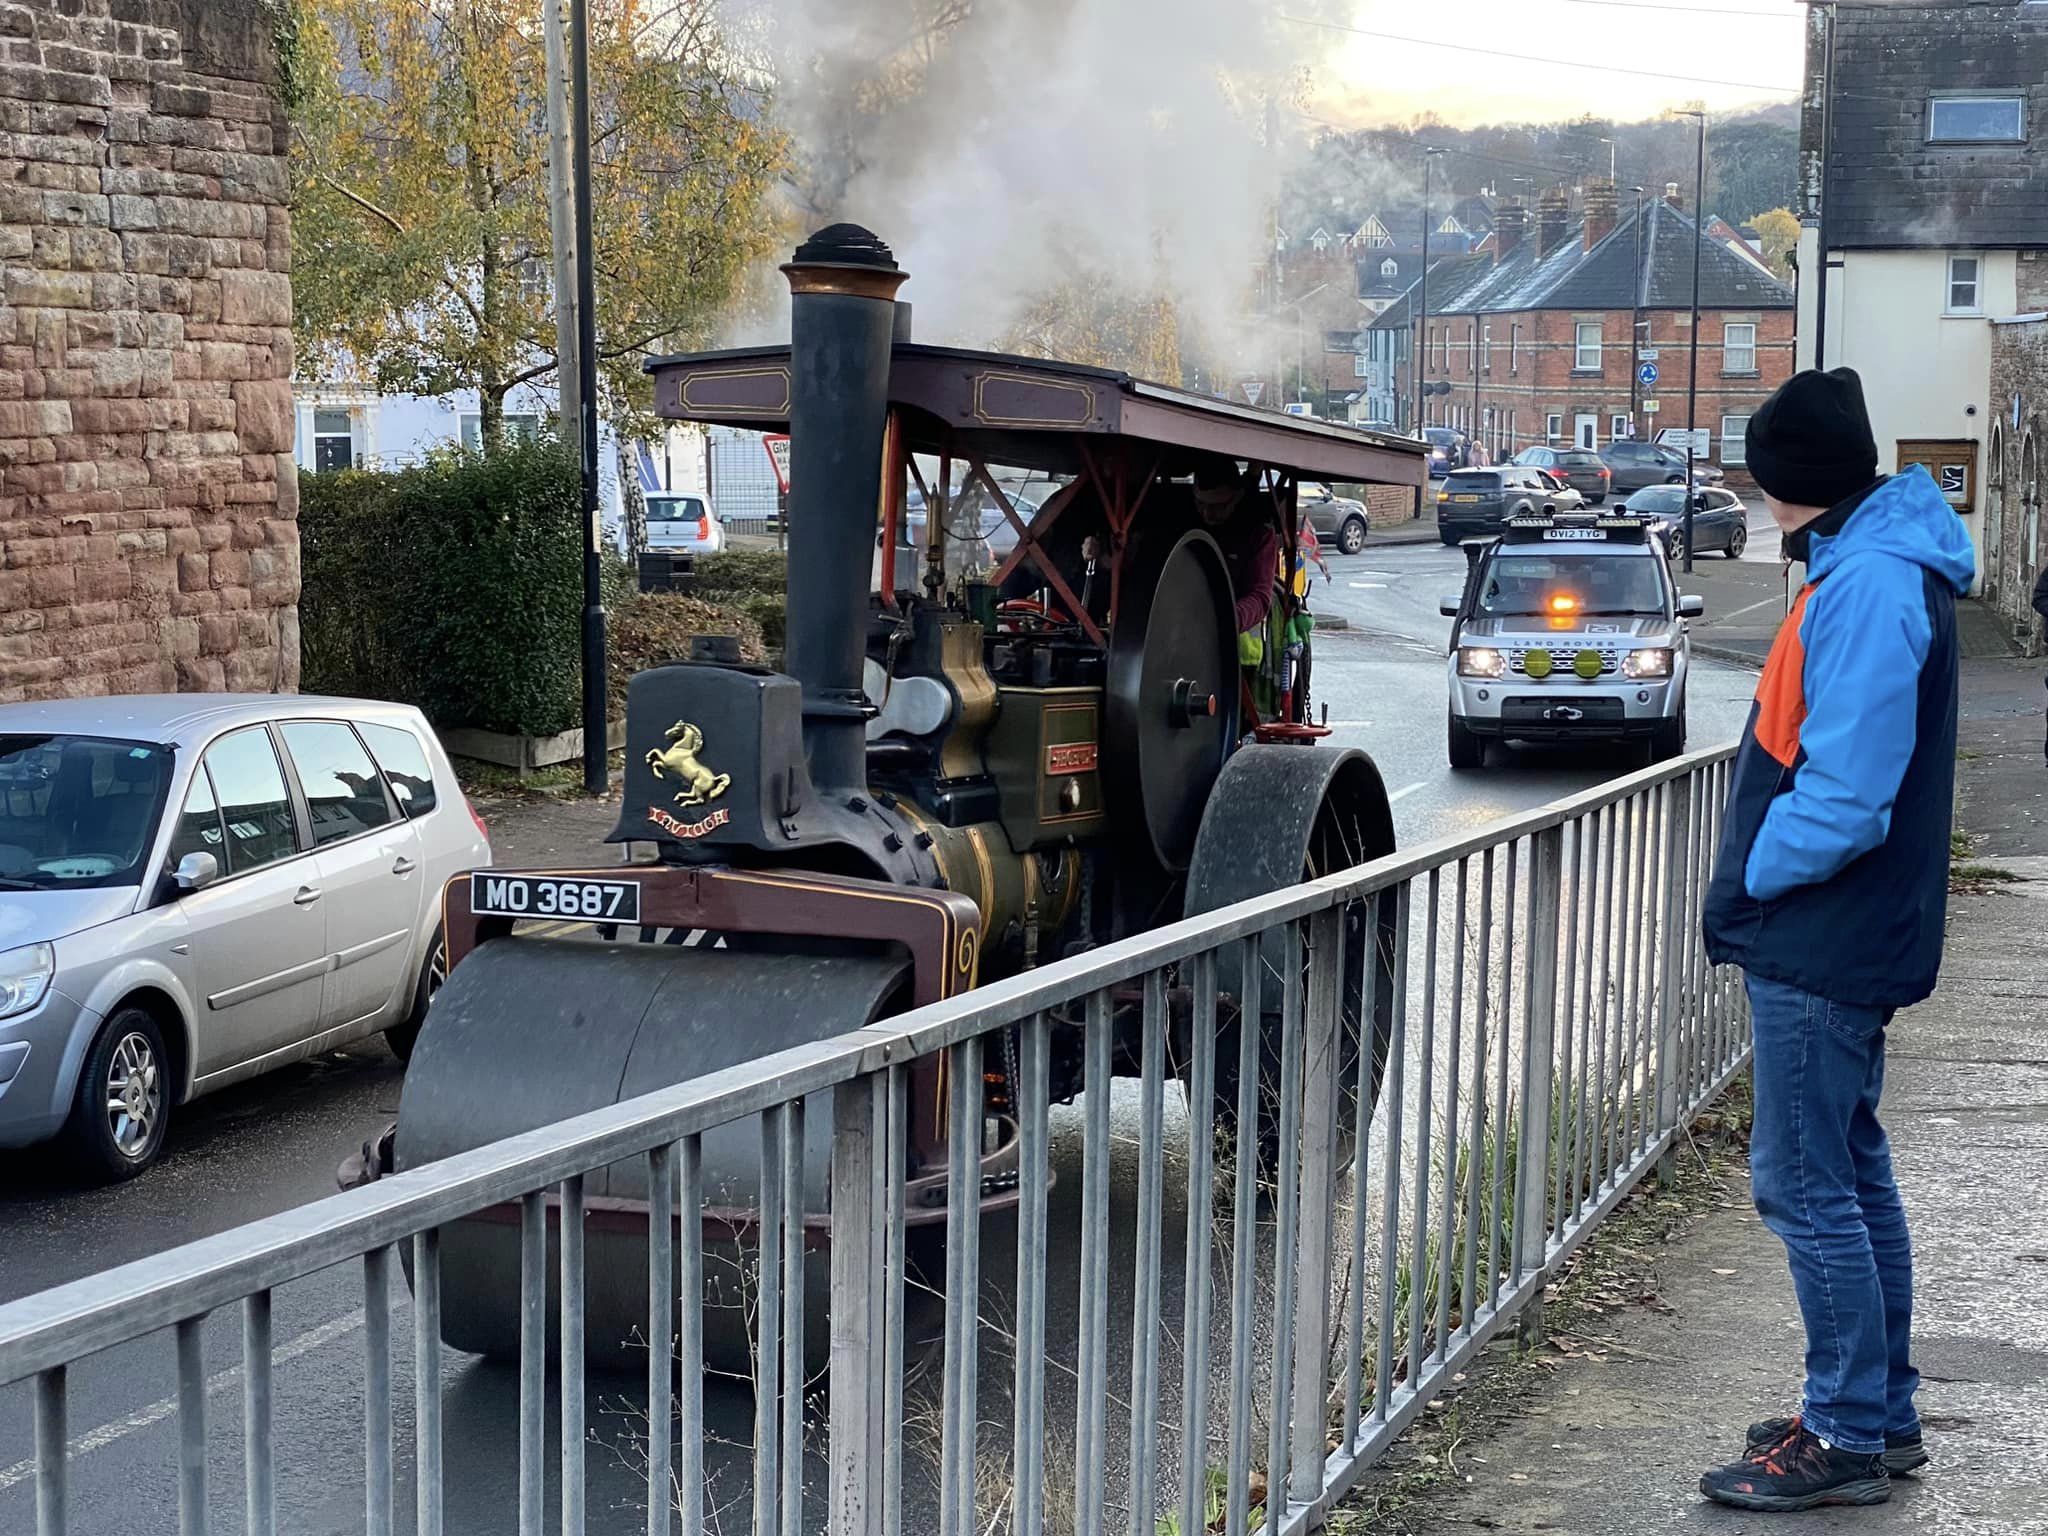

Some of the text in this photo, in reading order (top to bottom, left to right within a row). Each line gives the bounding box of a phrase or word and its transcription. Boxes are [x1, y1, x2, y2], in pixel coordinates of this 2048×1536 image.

[1550, 529, 1601, 538] OV12 TYG
[486, 879, 624, 917] MO 3687
